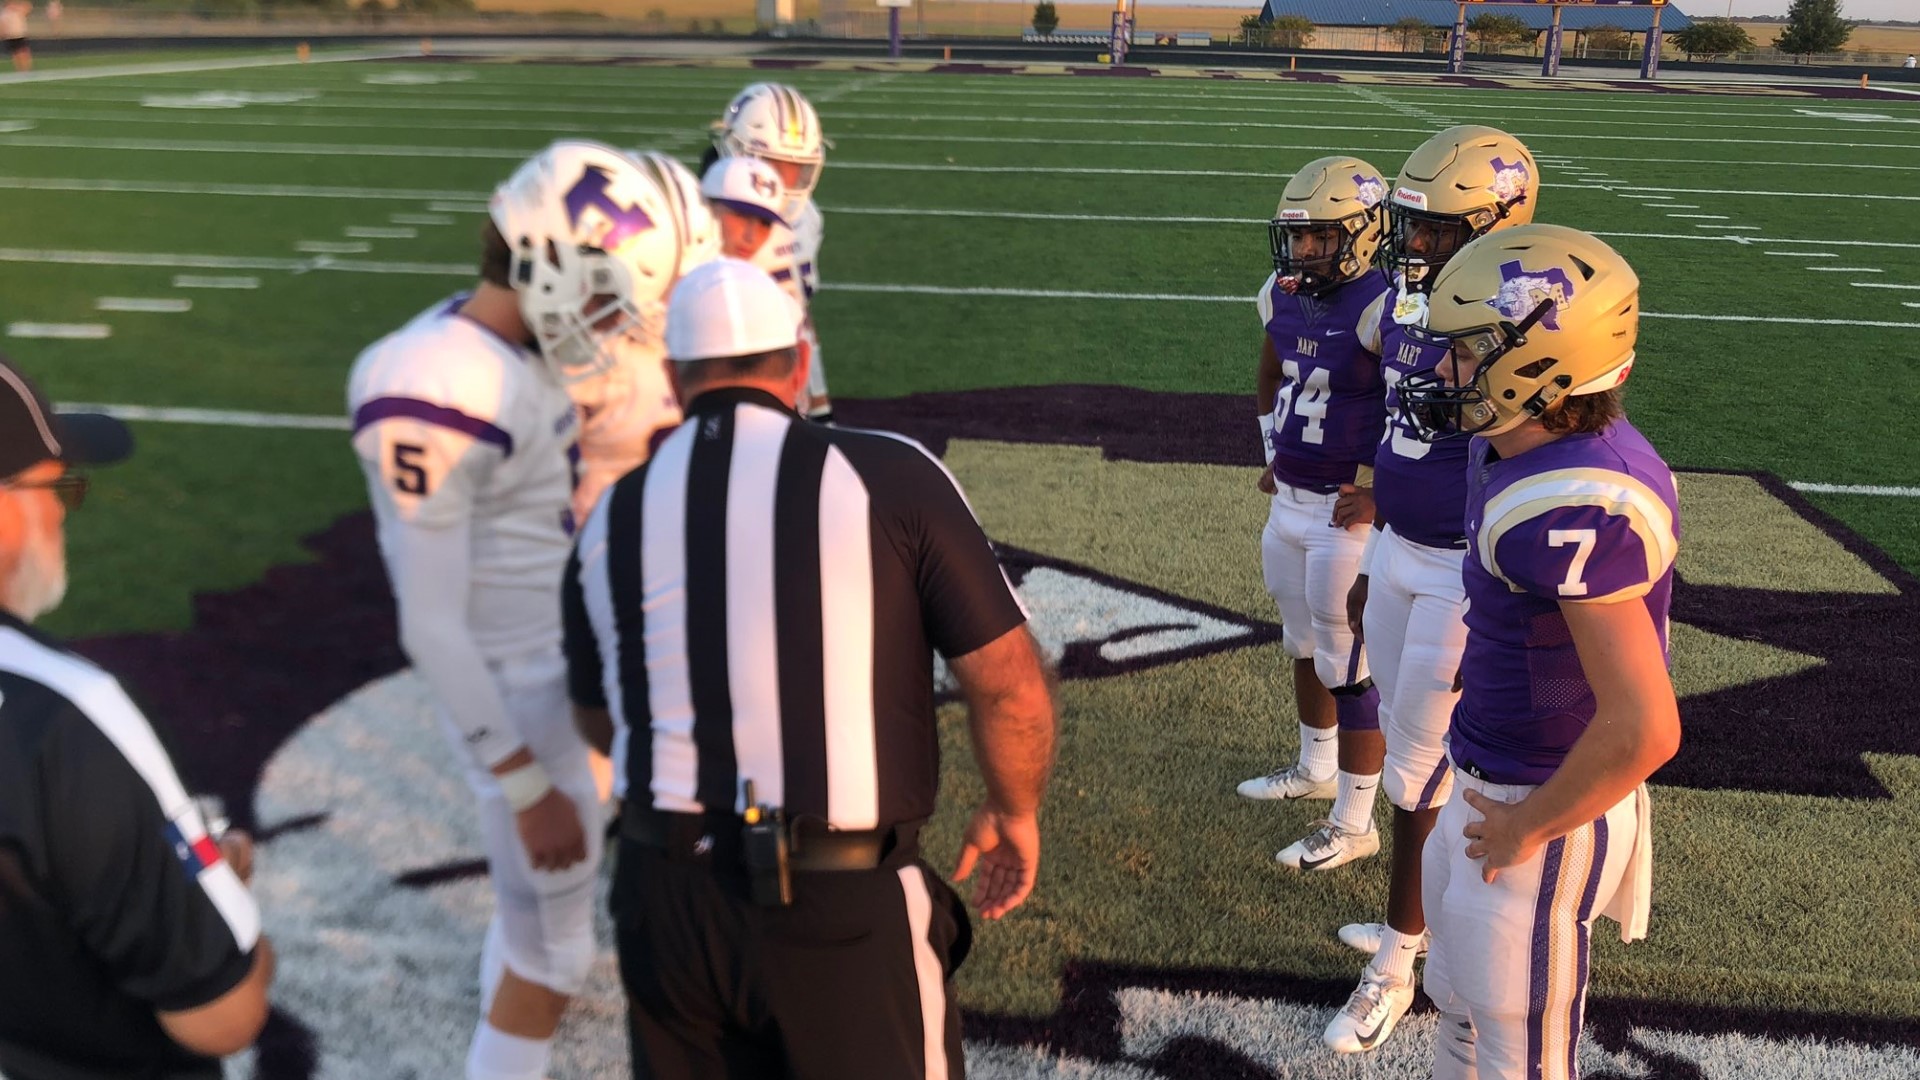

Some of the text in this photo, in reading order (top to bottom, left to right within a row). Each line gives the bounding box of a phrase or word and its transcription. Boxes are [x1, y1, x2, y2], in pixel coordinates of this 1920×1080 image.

[1453, 24, 1465, 73] MART
[1295, 335, 1319, 359] MART
[1396, 341, 1422, 367] MART
[393, 442, 429, 496] 5
[1547, 528, 1597, 596] 7
